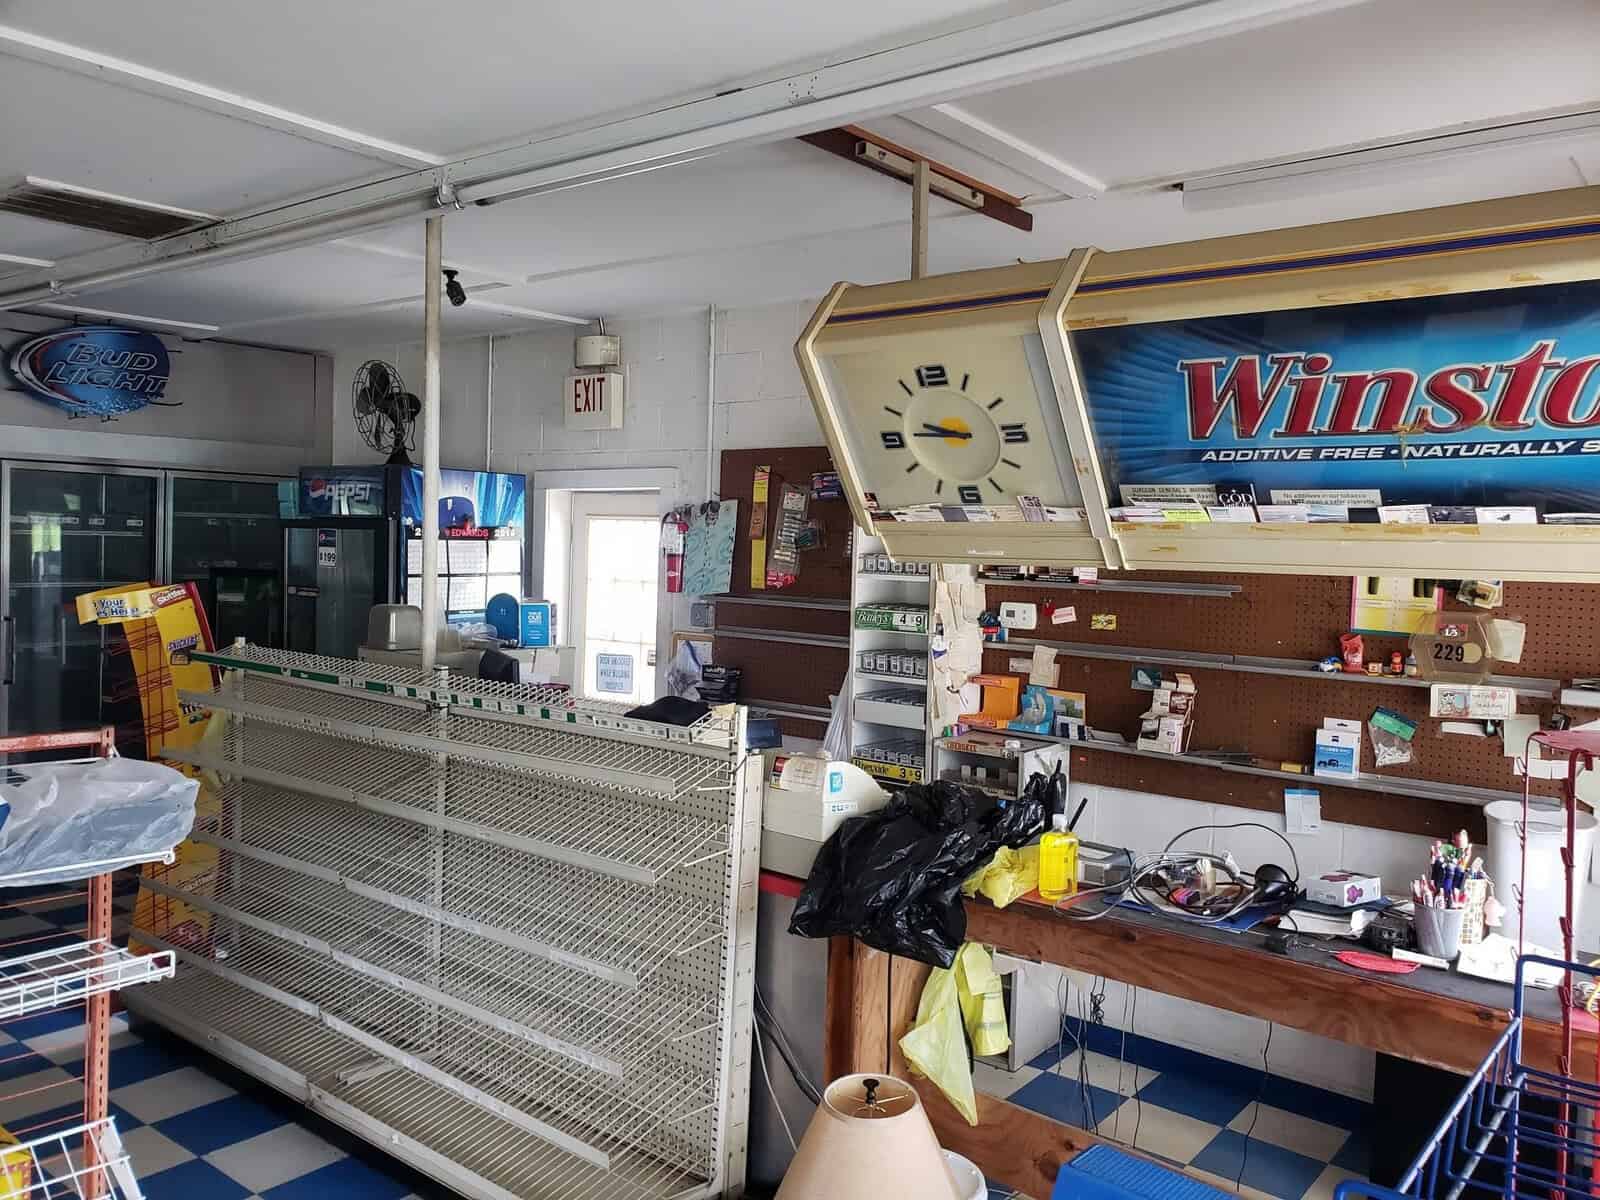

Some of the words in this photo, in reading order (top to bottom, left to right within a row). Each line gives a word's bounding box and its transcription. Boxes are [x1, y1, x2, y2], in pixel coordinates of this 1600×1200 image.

[67, 343, 158, 371] BUD
[43, 361, 169, 393] LIGHT
[914, 366, 949, 387] 12
[575, 377, 605, 412] EXIT
[881, 431, 906, 450] 9
[1201, 447, 1311, 462] ADDITIVE
[1319, 445, 1385, 460] FREE
[1404, 439, 1575, 458] NATURALLY
[325, 483, 371, 500] PEPSI
[958, 486, 983, 504] 6
[451, 528, 489, 537] EDWARDS
[1433, 642, 1465, 662] 229
